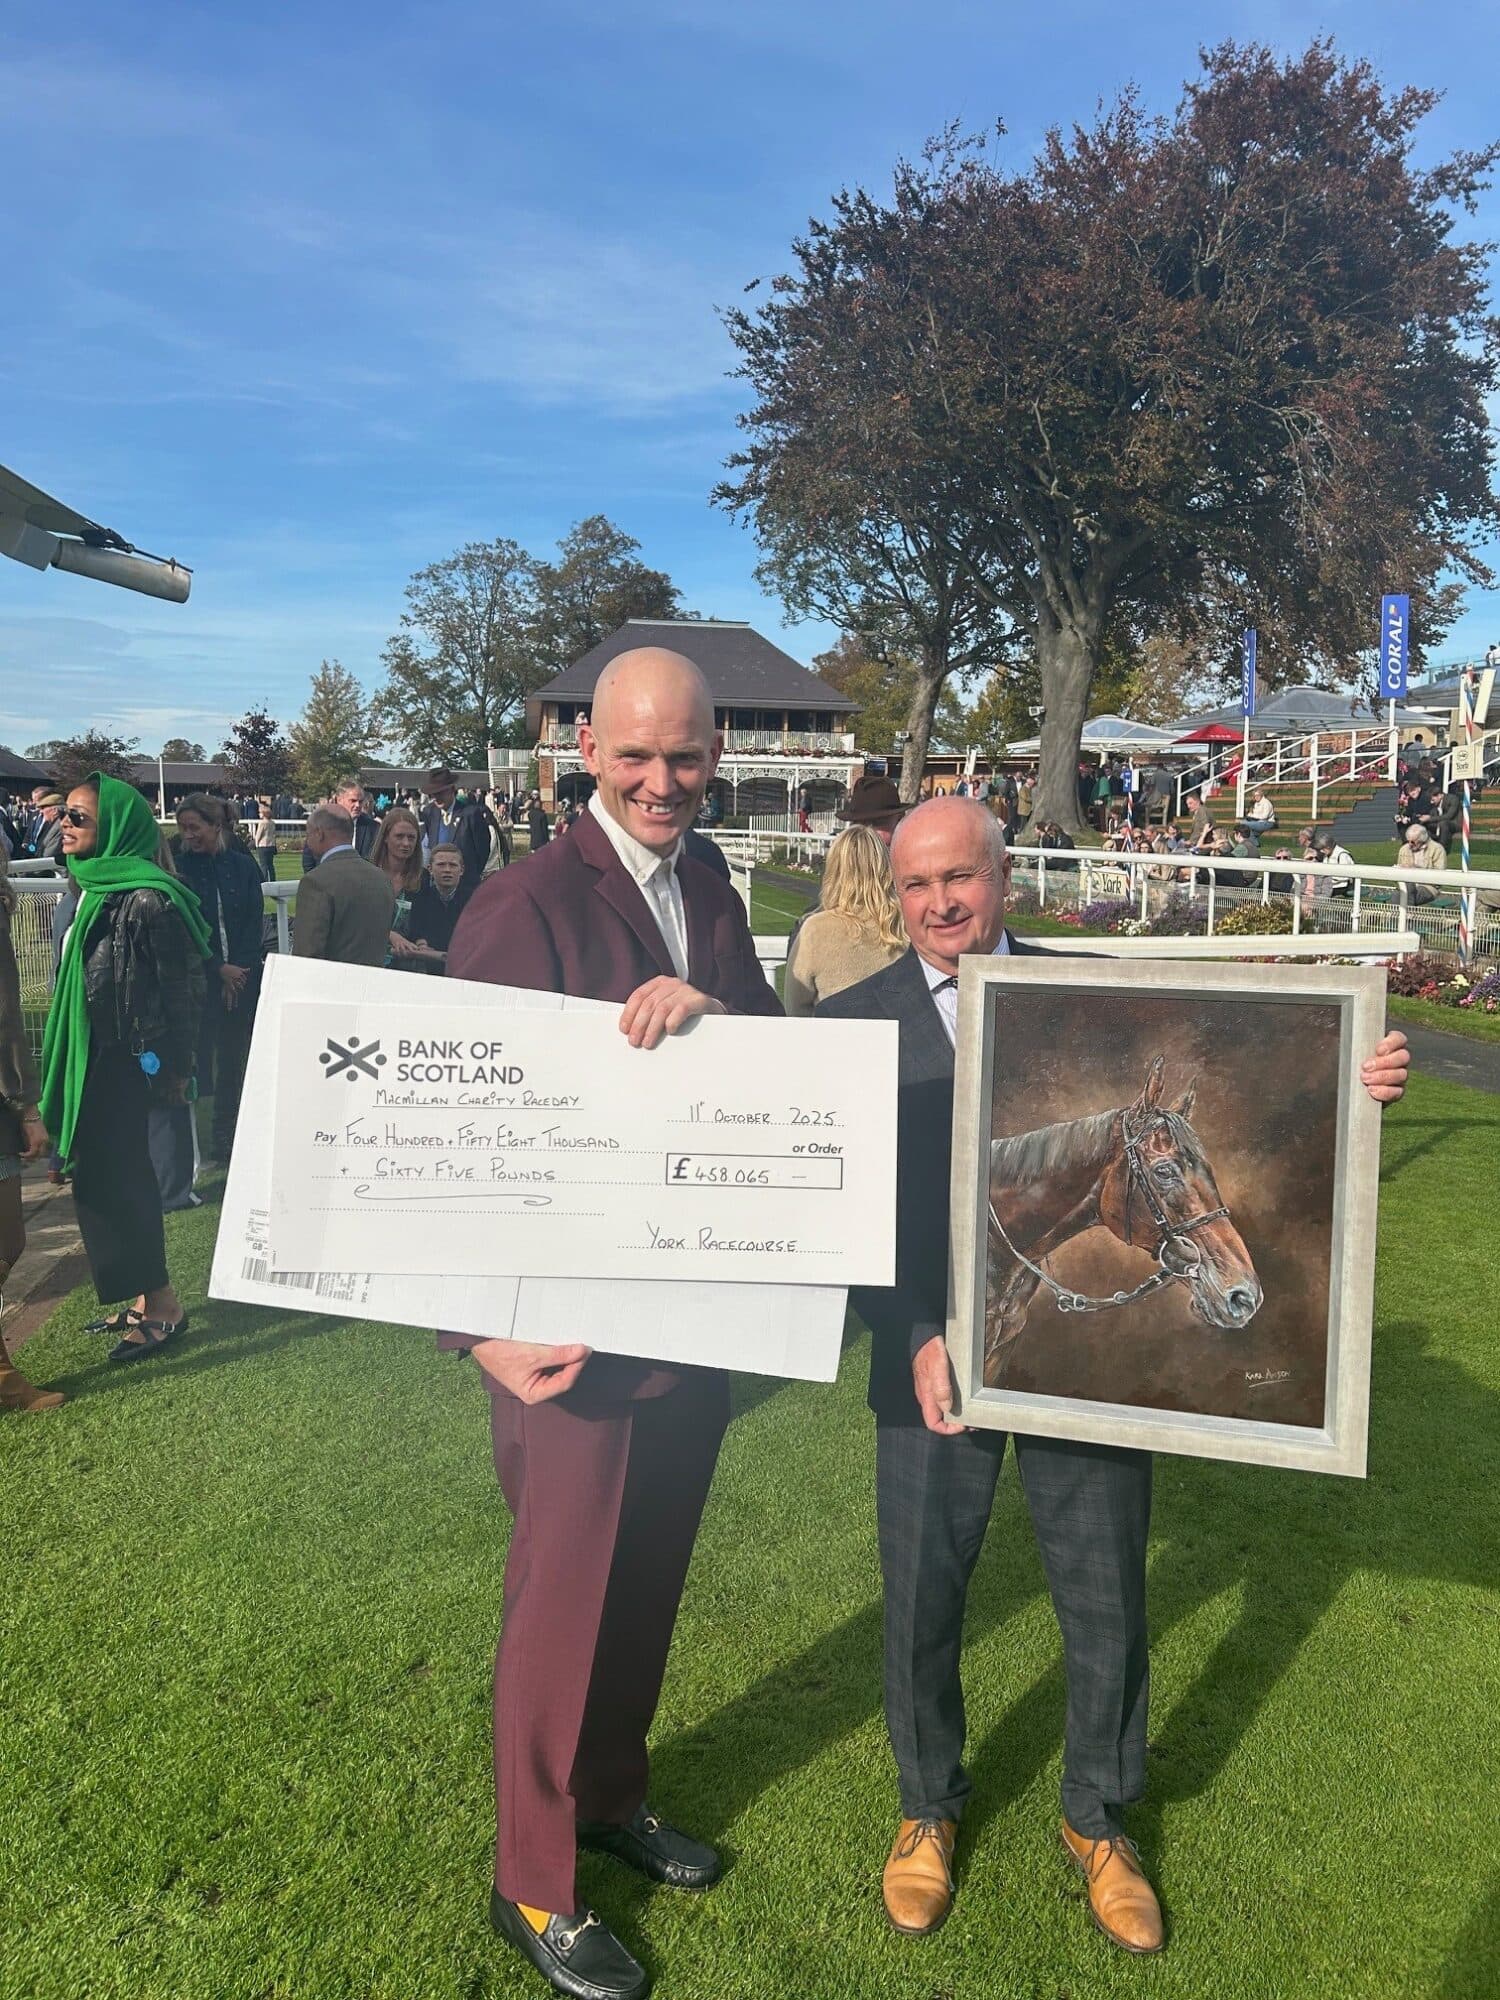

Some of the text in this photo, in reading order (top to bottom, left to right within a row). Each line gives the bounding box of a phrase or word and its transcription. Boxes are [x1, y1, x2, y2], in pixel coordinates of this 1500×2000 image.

[1388, 616, 1403, 690] CORAL
[1102, 873, 1122, 894] York
[398, 1040, 503, 1060] BANK OF
[397, 1064, 524, 1084] SCOTLAND
[714, 1108, 770, 1124] OCTOBER
[789, 1107, 837, 1126] 2025
[315, 1131, 338, 1144] Pay
[345, 1117, 378, 1145] FOUR
[385, 1123, 444, 1146] HUNDRED
[541, 1125, 620, 1149] THOUSAND
[792, 1143, 843, 1154] or Order
[491, 1157, 556, 1181] POUNDS
[647, 1221, 798, 1251] YORK RACECOURSE
